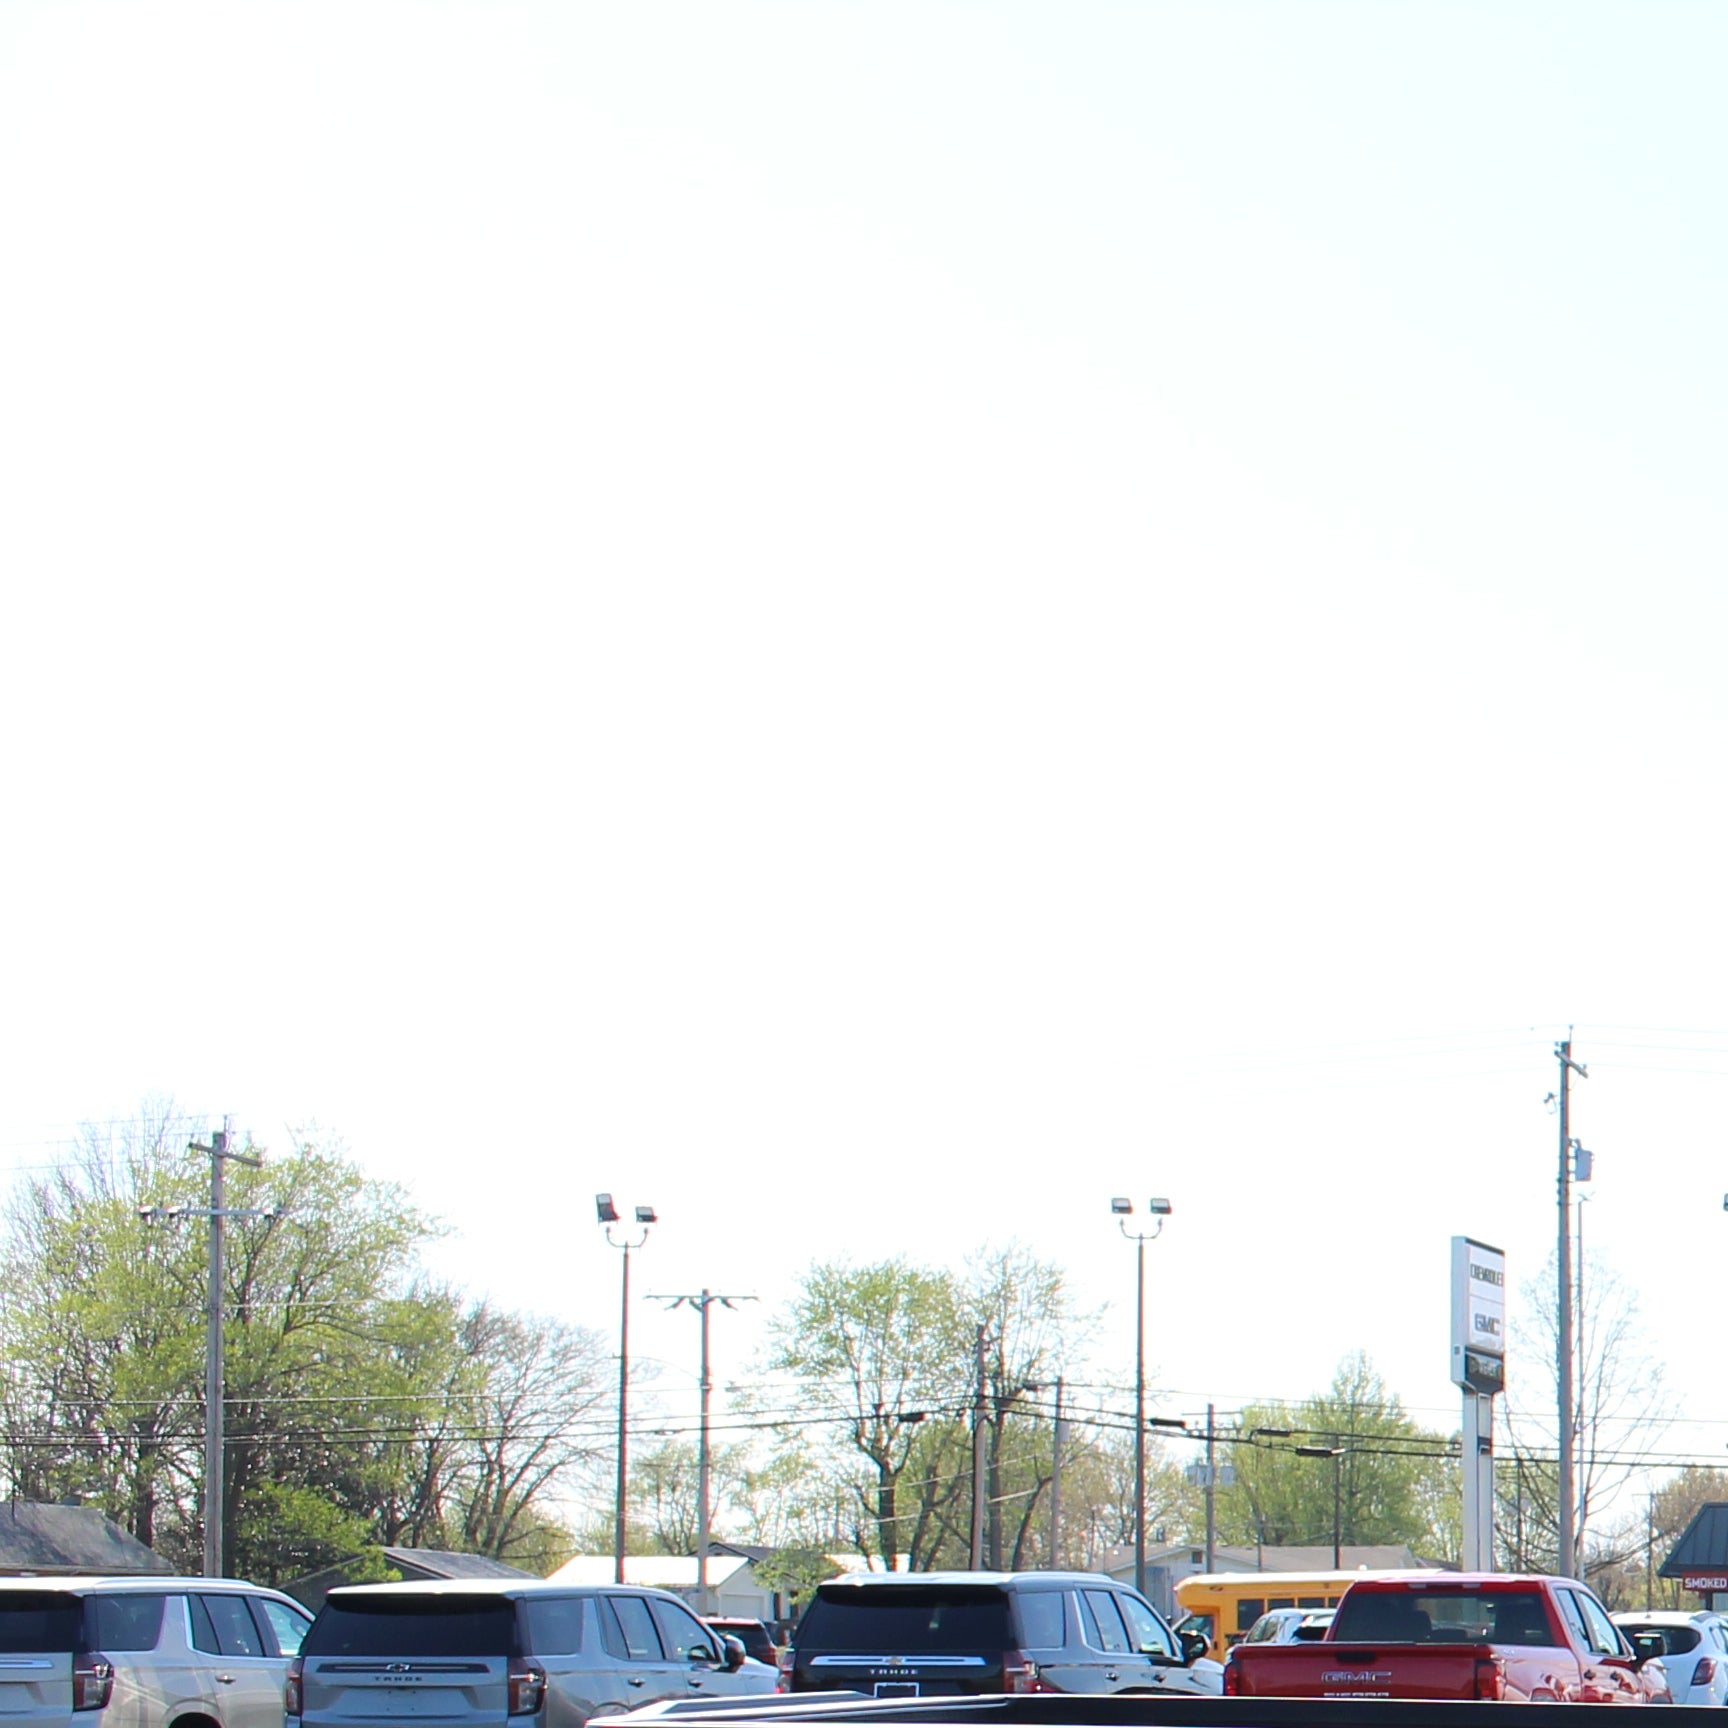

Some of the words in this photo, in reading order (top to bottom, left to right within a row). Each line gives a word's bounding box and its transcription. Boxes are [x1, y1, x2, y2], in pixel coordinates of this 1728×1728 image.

[1474, 1312, 1500, 1336] GMC
[1685, 1577, 1728, 1589] SMOKED
[1321, 1670, 1392, 1685] GMC
